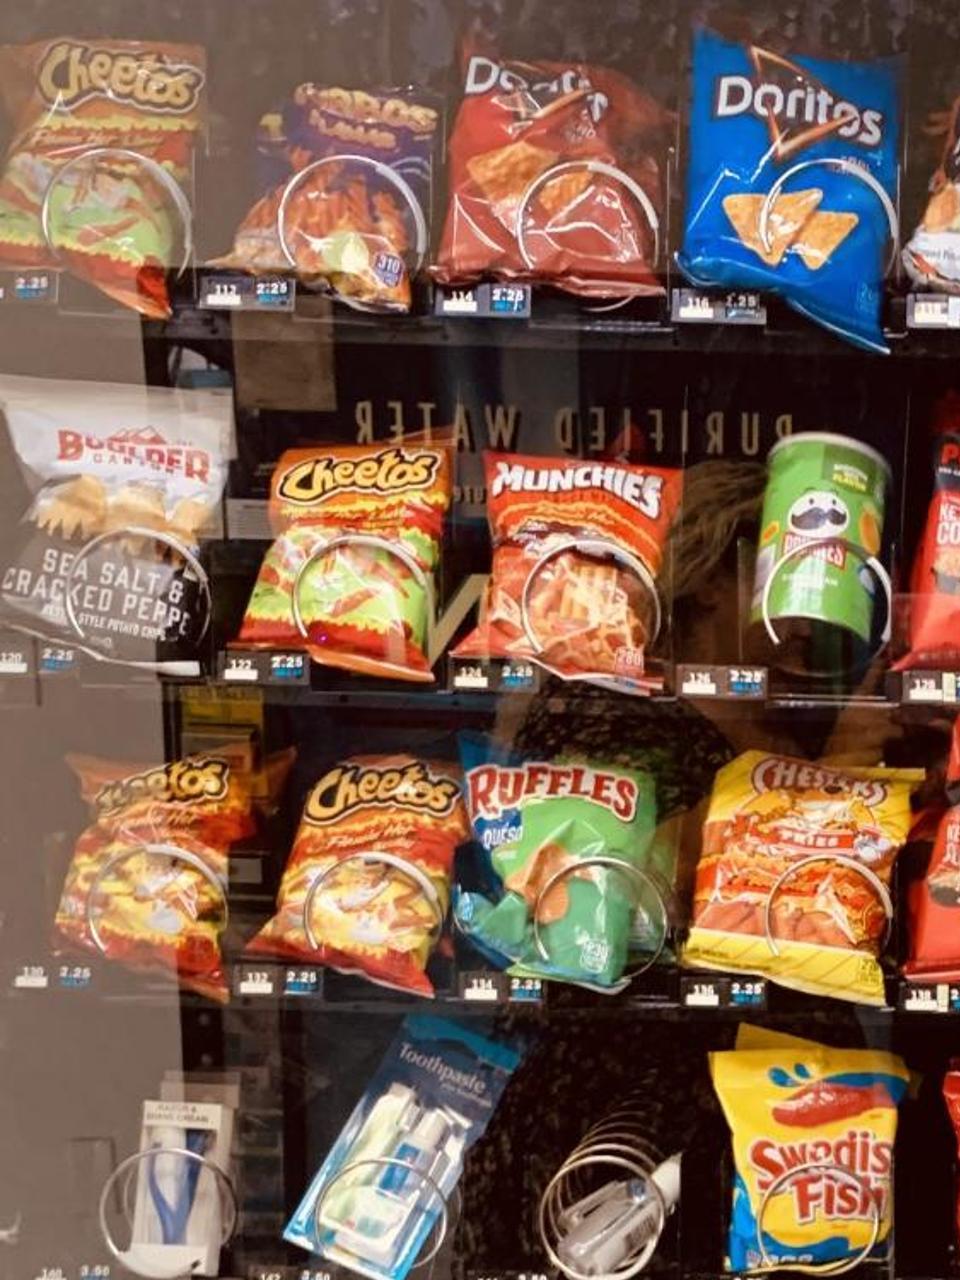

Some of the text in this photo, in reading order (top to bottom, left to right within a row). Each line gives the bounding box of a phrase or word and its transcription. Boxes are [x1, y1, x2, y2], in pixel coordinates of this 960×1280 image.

[39, 43, 200, 108] Cheetos
[716, 75, 883, 147] Doritos
[279, 450, 438, 501] Cheetos
[492, 461, 663, 520] MUNCHIES
[2, 568, 112, 612] CRACKED
[43, 549, 183, 604] SEA SALT &
[305, 763, 456, 821] Cheetos
[468, 764, 637, 820] RUFFLES
[400, 1041, 487, 1094] Toothpaste
[750, 1131, 894, 1190] Swedis
[791, 1174, 887, 1220] Fish
